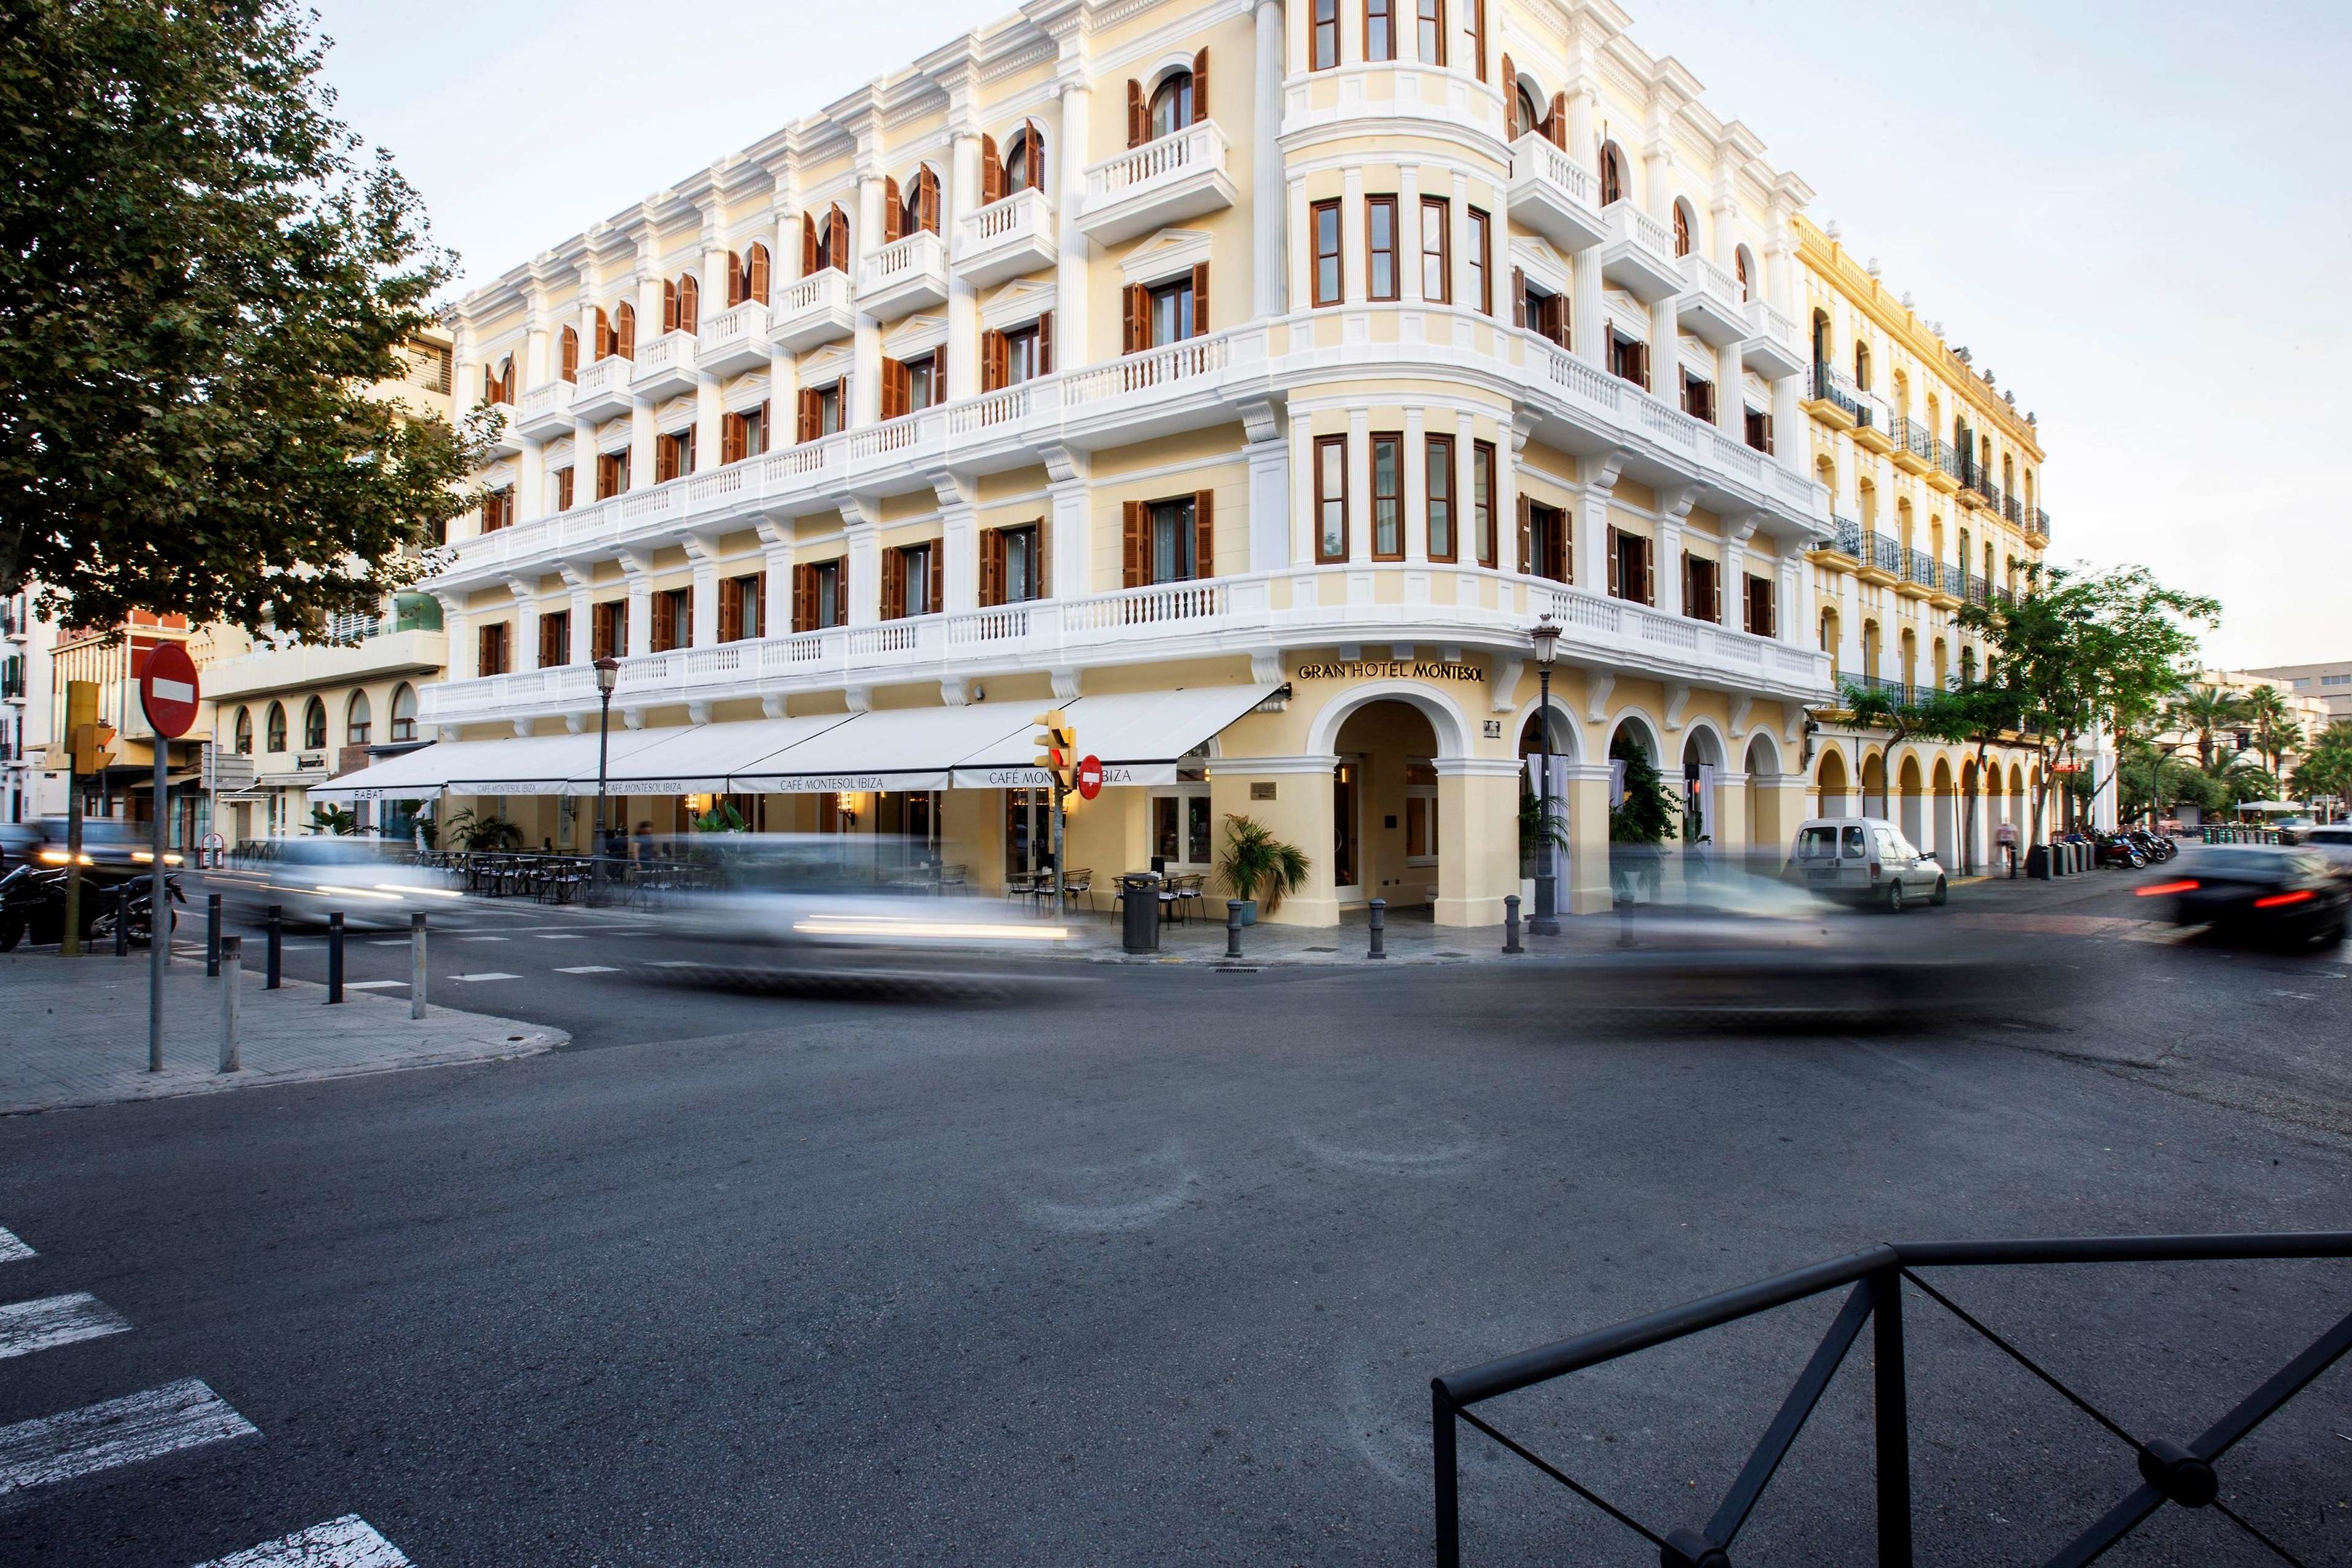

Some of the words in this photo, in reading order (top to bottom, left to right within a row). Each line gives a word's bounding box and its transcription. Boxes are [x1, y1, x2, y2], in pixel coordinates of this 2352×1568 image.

[1299, 663, 1346, 679] GRAN
[1352, 663, 1408, 677] HOTEL
[1413, 662, 1485, 682] MONTESOL
[989, 767, 1018, 785] CAFÉ
[1102, 769, 1131, 782] BIZA
[493, 784, 520, 793] MONTESOL
[523, 784, 536, 793] IBIZA
[624, 783, 661, 793] MONTESOL
[663, 783, 682, 792] IBIZA
[780, 776, 802, 791] CAFÉ
[804, 778, 856, 790] MONTESOL
[858, 777, 883, 788] IBIZA
[354, 789, 384, 799] RABAT
